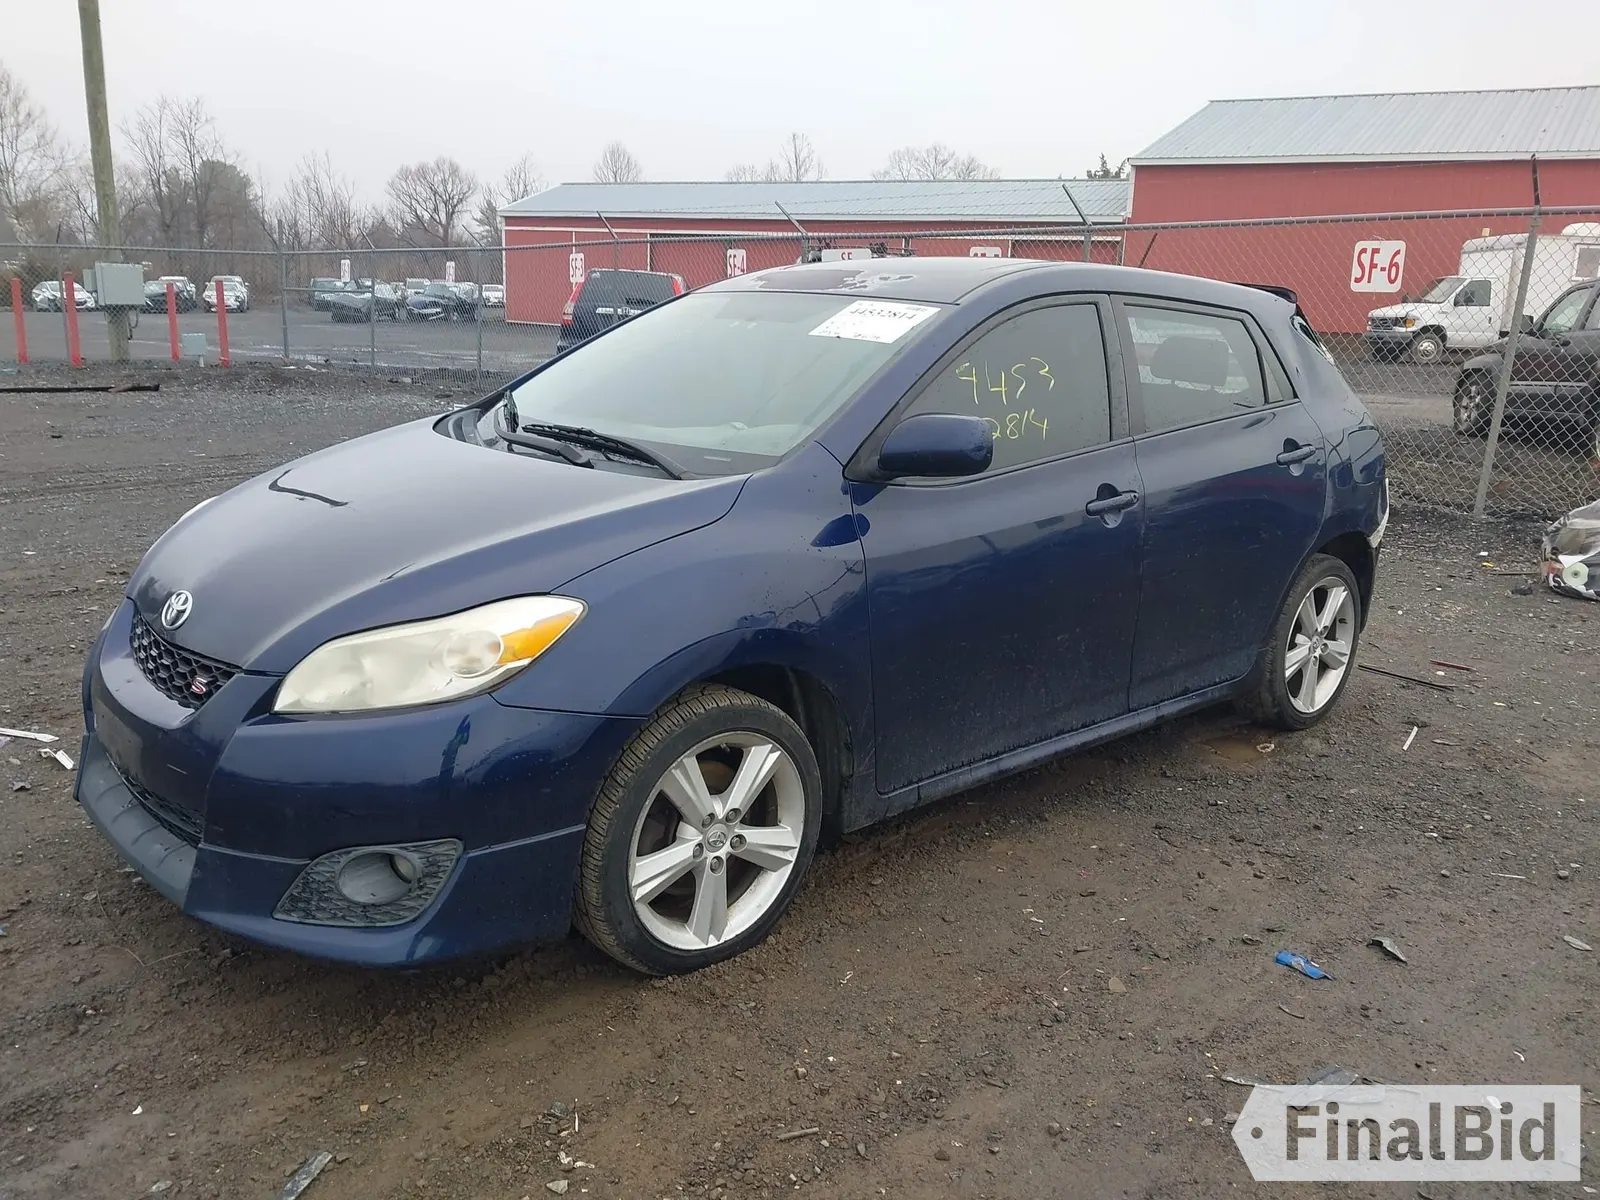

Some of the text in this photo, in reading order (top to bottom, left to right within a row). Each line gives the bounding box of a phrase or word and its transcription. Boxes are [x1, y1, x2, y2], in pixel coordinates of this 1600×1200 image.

[571, 257, 584, 278] SF-3
[729, 254, 745, 276] SF-4
[1354, 247, 1401, 285] SF-6
[981, 408, 1049, 441] 2814
[190, 676, 207, 695] S
